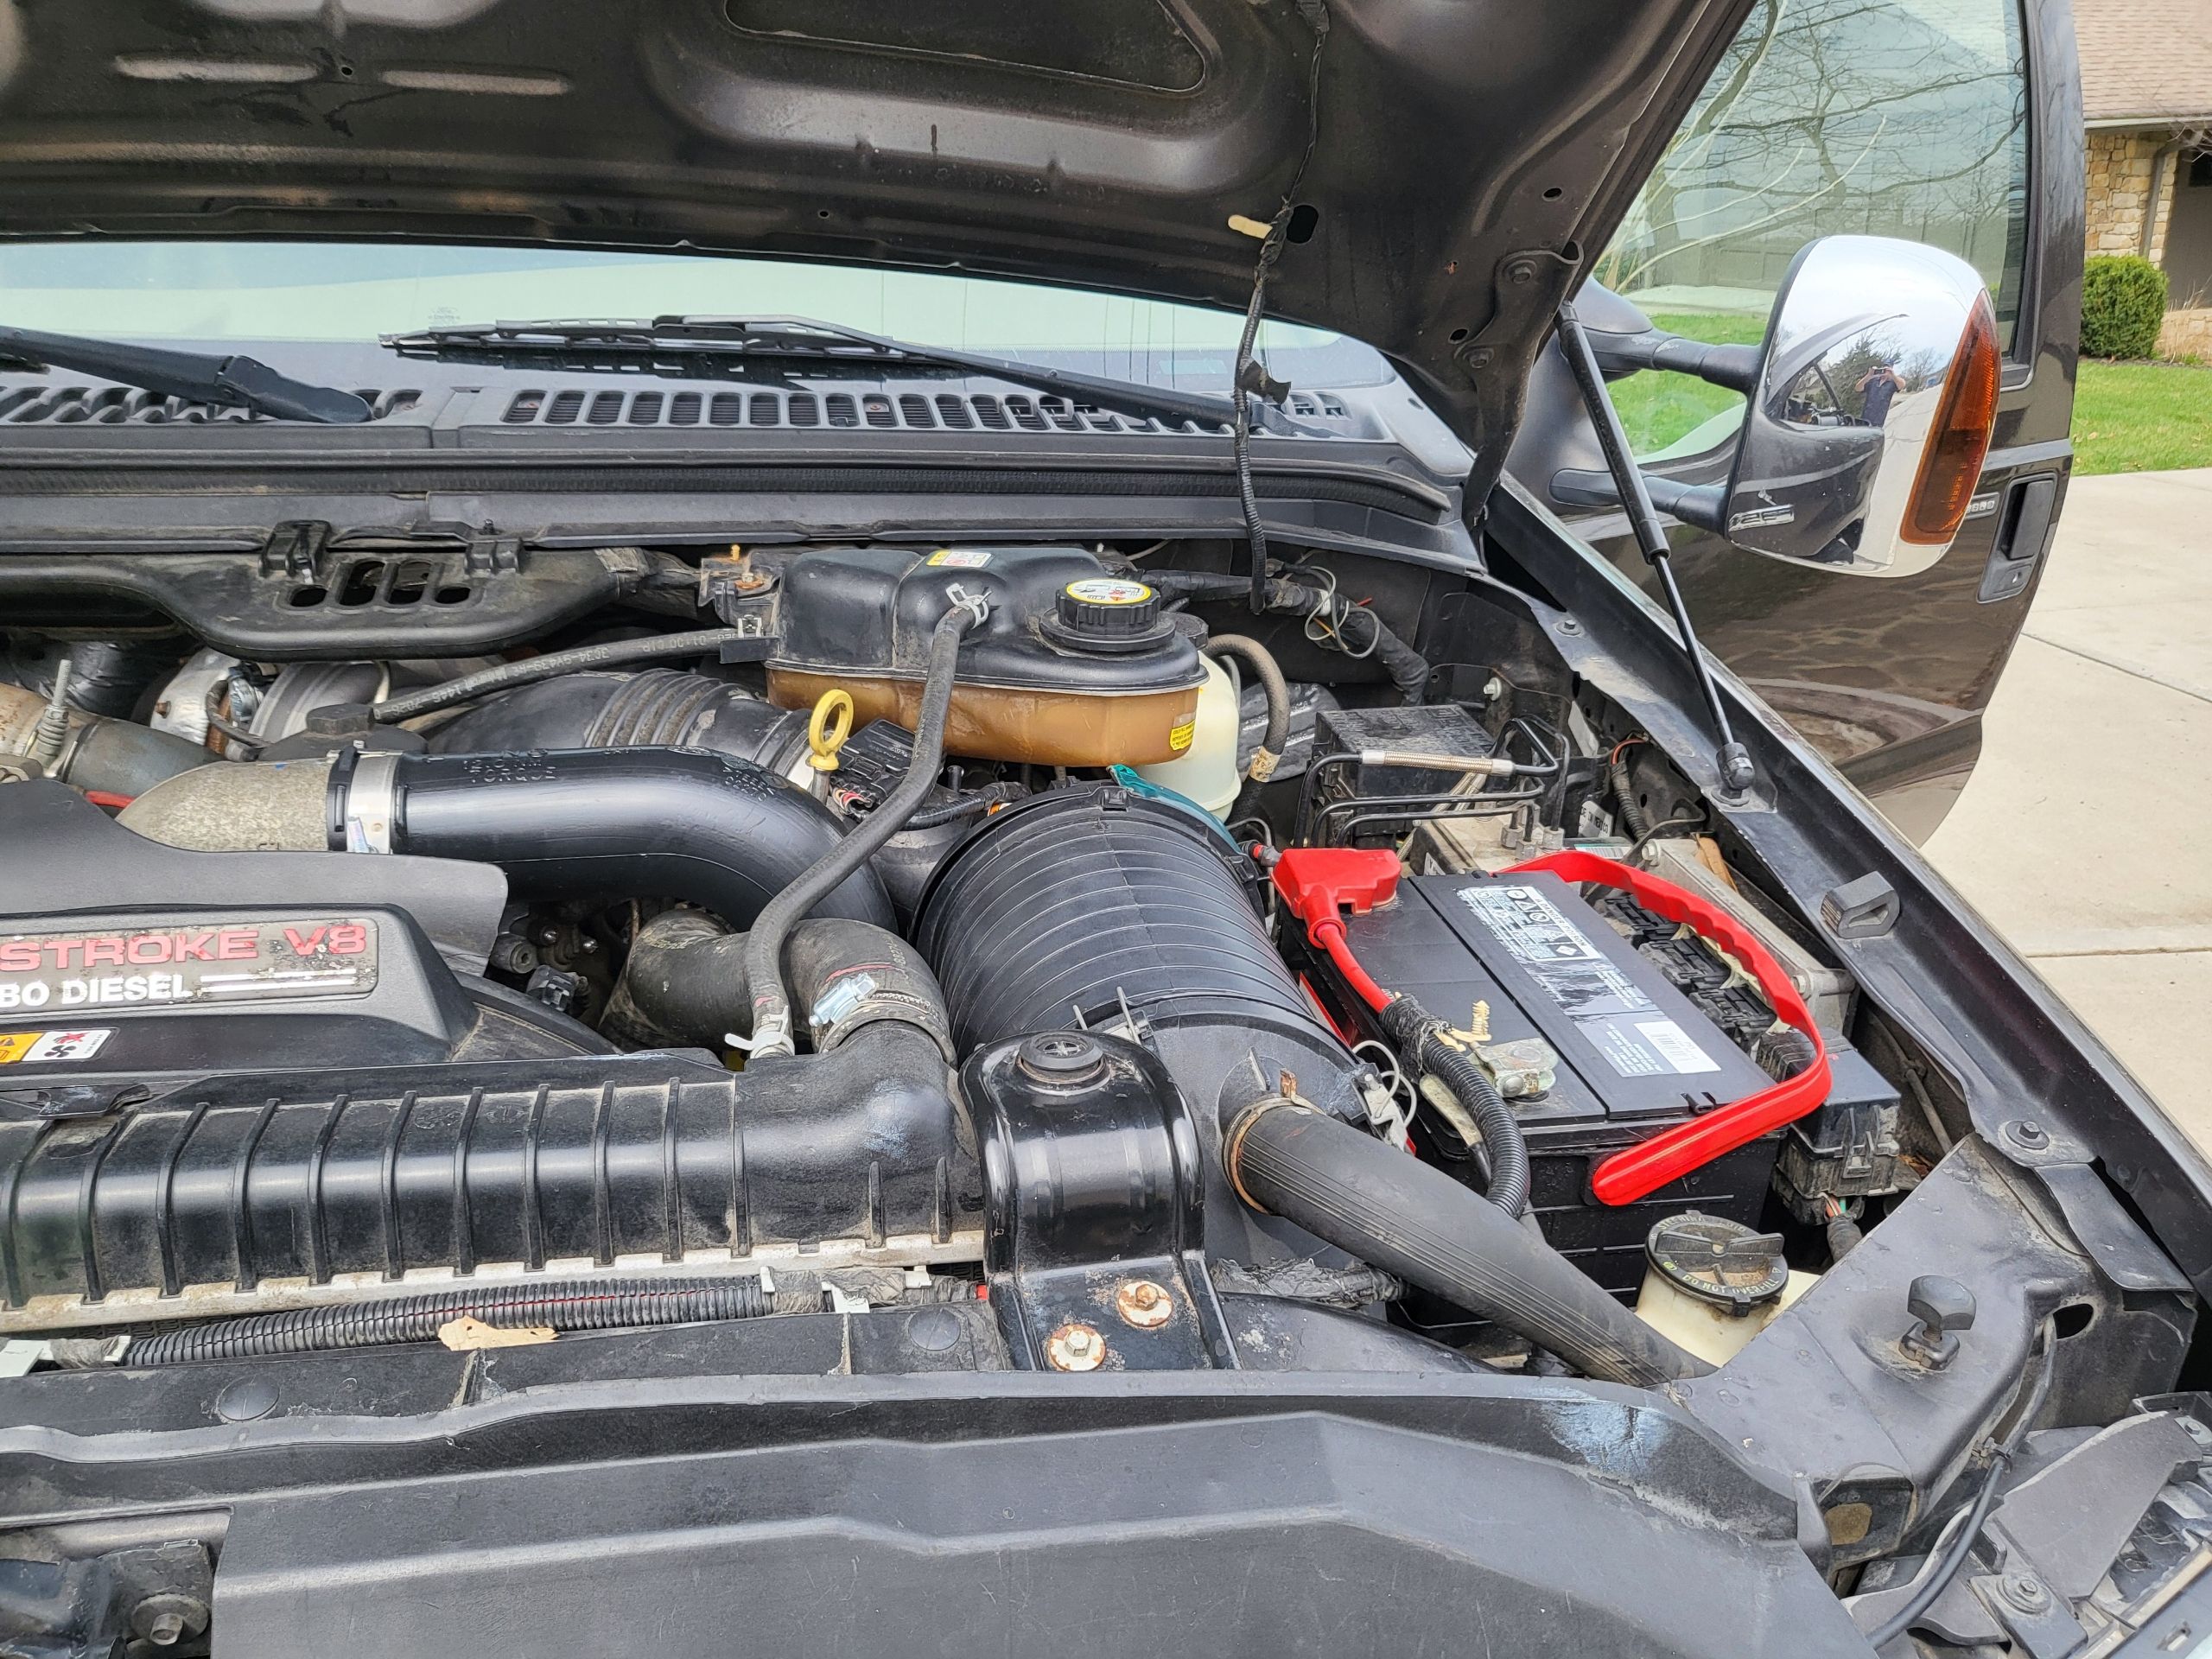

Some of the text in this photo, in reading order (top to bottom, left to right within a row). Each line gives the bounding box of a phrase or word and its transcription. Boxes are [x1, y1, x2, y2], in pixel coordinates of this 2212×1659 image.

[468, 766, 557, 783] TORQUE
[0, 925, 366, 972] STROKE V8
[61, 974, 193, 1005] DIESEL
[1681, 1274, 1780, 1294] DO NOT OVERFILL
